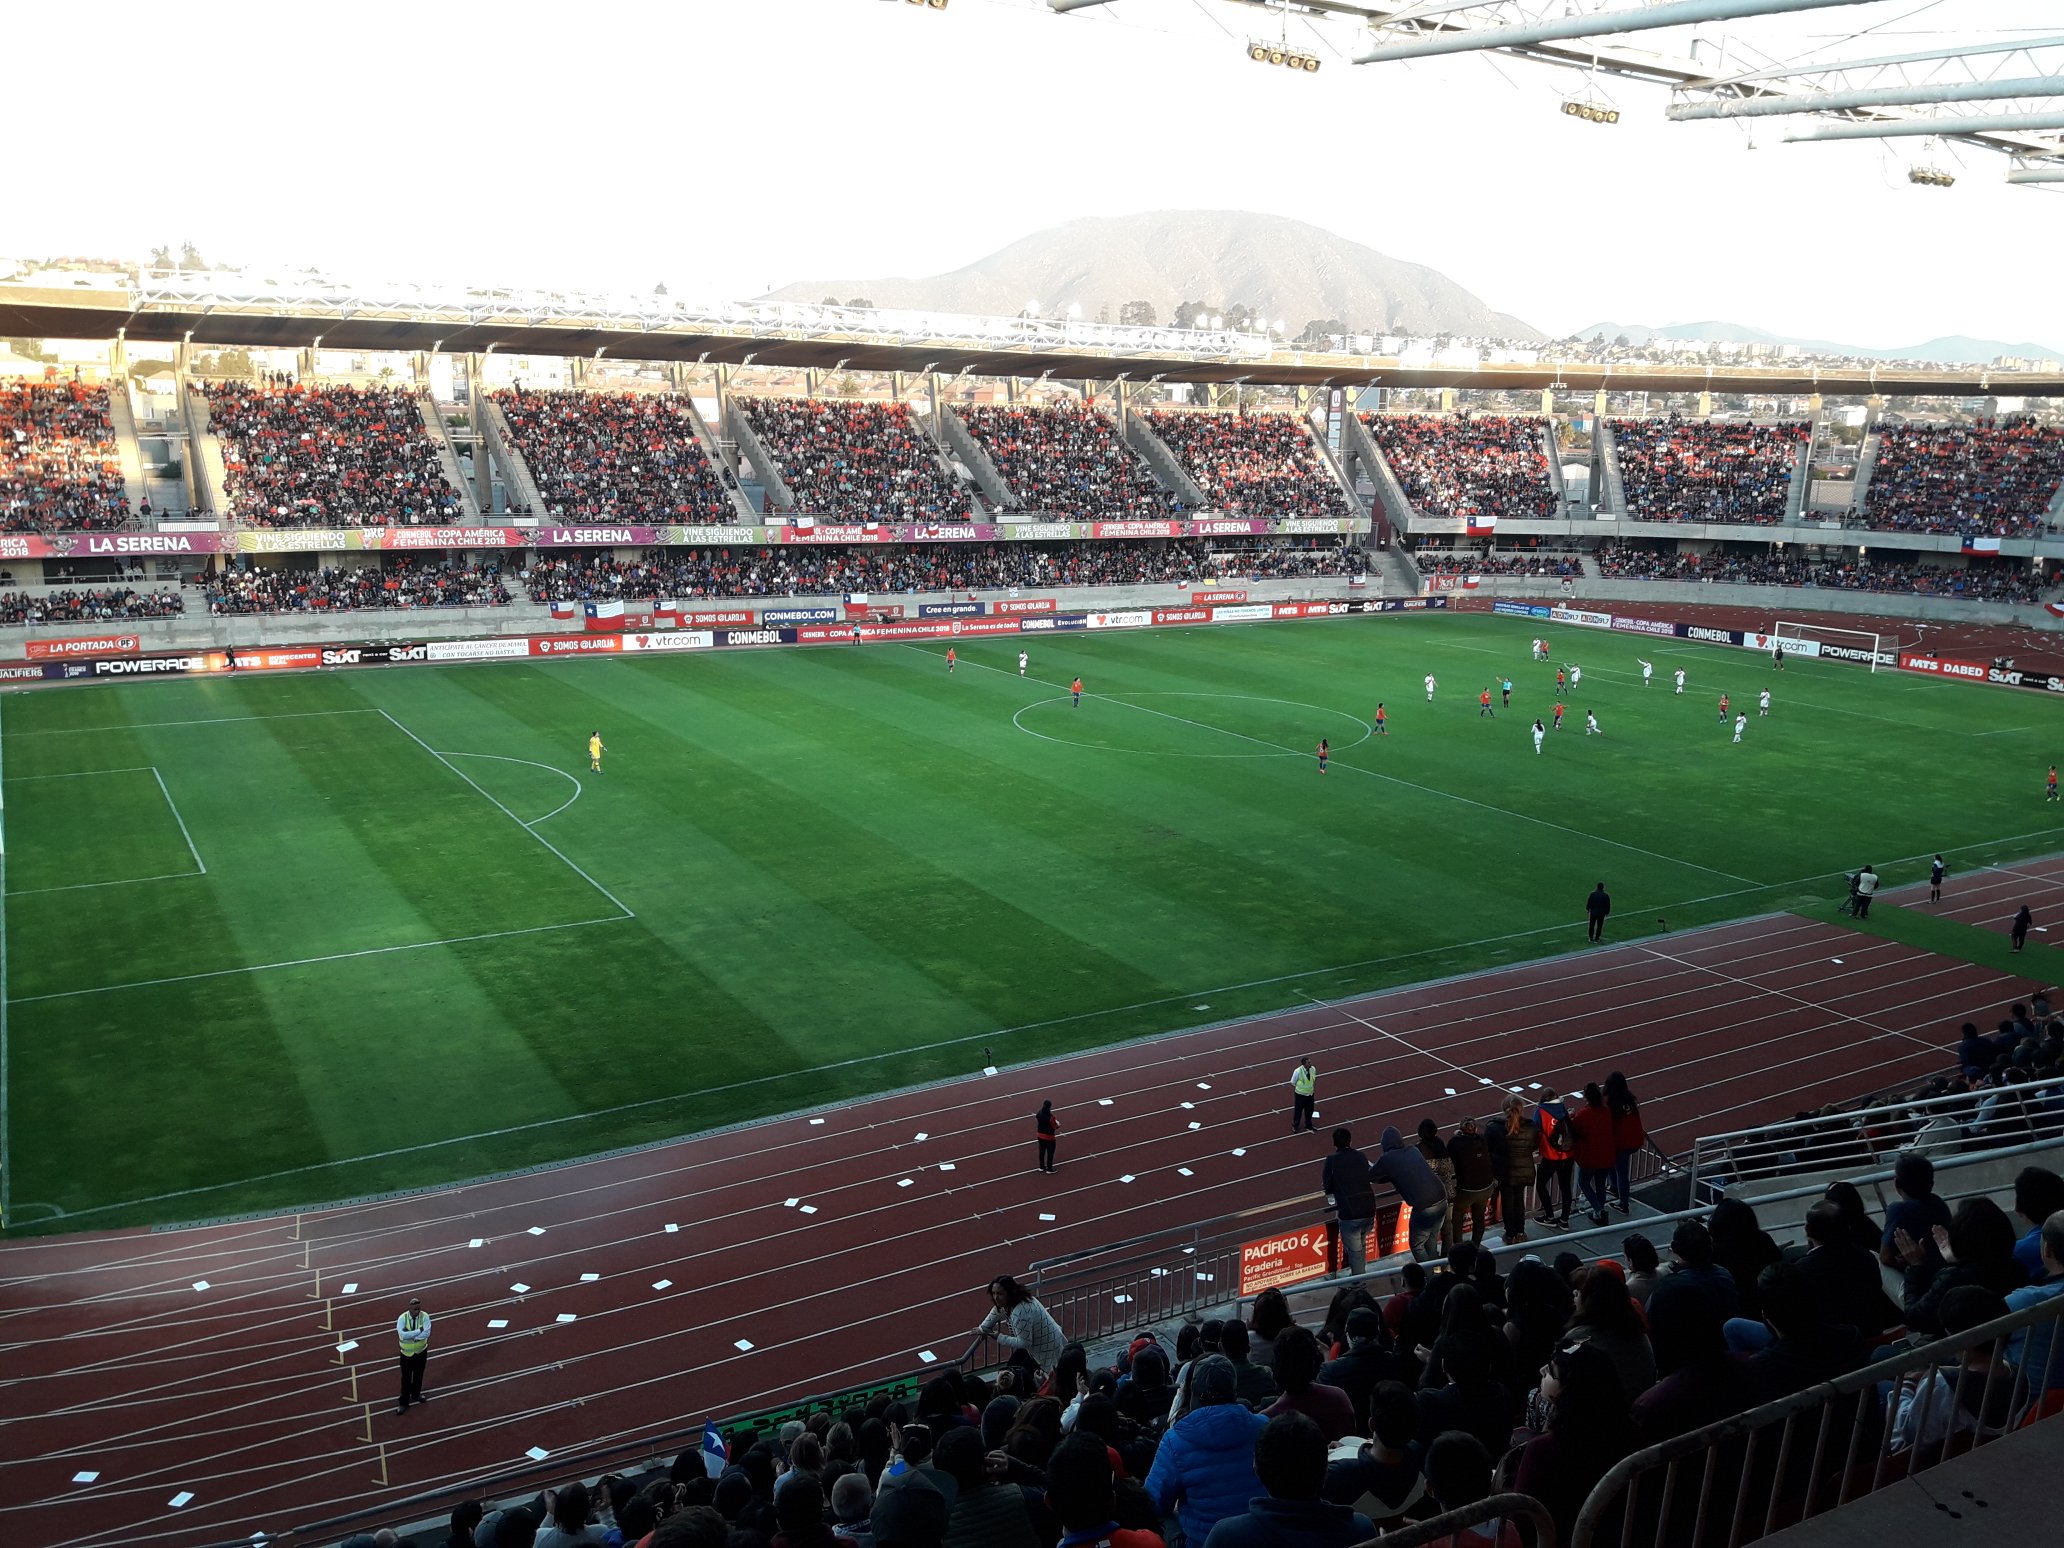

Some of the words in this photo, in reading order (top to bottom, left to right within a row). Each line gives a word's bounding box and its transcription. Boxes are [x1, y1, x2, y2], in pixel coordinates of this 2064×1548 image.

[683, 528, 704, 536] VINE
[706, 528, 753, 536] SIGUIENDO
[825, 527, 845, 535] COPA
[1015, 524, 1032, 532] VINE
[1033, 524, 1071, 532] SIGUIENDO
[1199, 523, 1212, 533] LA
[1213, 522, 1251, 533] SERENA
[255, 533, 282, 543] VINE
[284, 532, 345, 542] SIGUIENDO
[437, 530, 461, 538] COPA
[465, 528, 505, 538] AMÉRICA
[553, 530, 573, 543] LA
[574, 529, 633, 542] SERENA
[840, 534, 861, 542] CHILE
[861, 534, 879, 542] 2018
[914, 527, 930, 539] LA
[1021, 531, 1034, 539] LAS
[1100, 529, 1139, 537] FEMENINA
[393, 538, 456, 547] FEMENINA
[457, 537, 484, 545] CHILE
[484, 537, 506, 545] 2018
[683, 535, 691, 543] A
[691, 535, 706, 543] LAS
[709, 535, 753, 543] ESTRELLAS
[90, 537, 115, 553] LA
[117, 536, 192, 551] SERENA
[255, 542, 265, 551] A
[266, 541, 286, 550] LAS
[288, 540, 346, 550] ESTRELLAS
[2, 548, 29, 557] 2018
[926, 606, 942, 614] Cree
[1278, 606, 1298, 615] MTS
[1307, 605, 1327, 613] MTS
[695, 614, 717, 623] SOMOS
[717, 613, 747, 622] @LAROJA
[764, 610, 835, 621] CONMEBOL.COM
[1110, 614, 1144, 625] vtr.com
[1022, 619, 1055, 629] CONMEBOL
[1612, 622, 1646, 631] FEMENINA
[848, 628, 876, 636] ARICA
[876, 627, 918, 635] FEMENINA
[1687, 626, 1732, 643] CONMEBOL
[656, 635, 701, 646] vtr.com
[728, 631, 782, 645] CONMEBOL
[50, 643, 64, 653] LA
[65, 640, 114, 651] PORTADA
[554, 640, 578, 650] SOMOS
[580, 638, 615, 649] @LAROJA
[1909, 658, 1939, 671] MTS
[1943, 663, 1984, 677] DABED
[1244, 1237, 1299, 1261] PACÍFICO
[1300, 1233, 1309, 1247] 6
[1262, 1265, 1291, 1278] Grandstand
[1301, 1263, 1324, 1274] BARANDA
